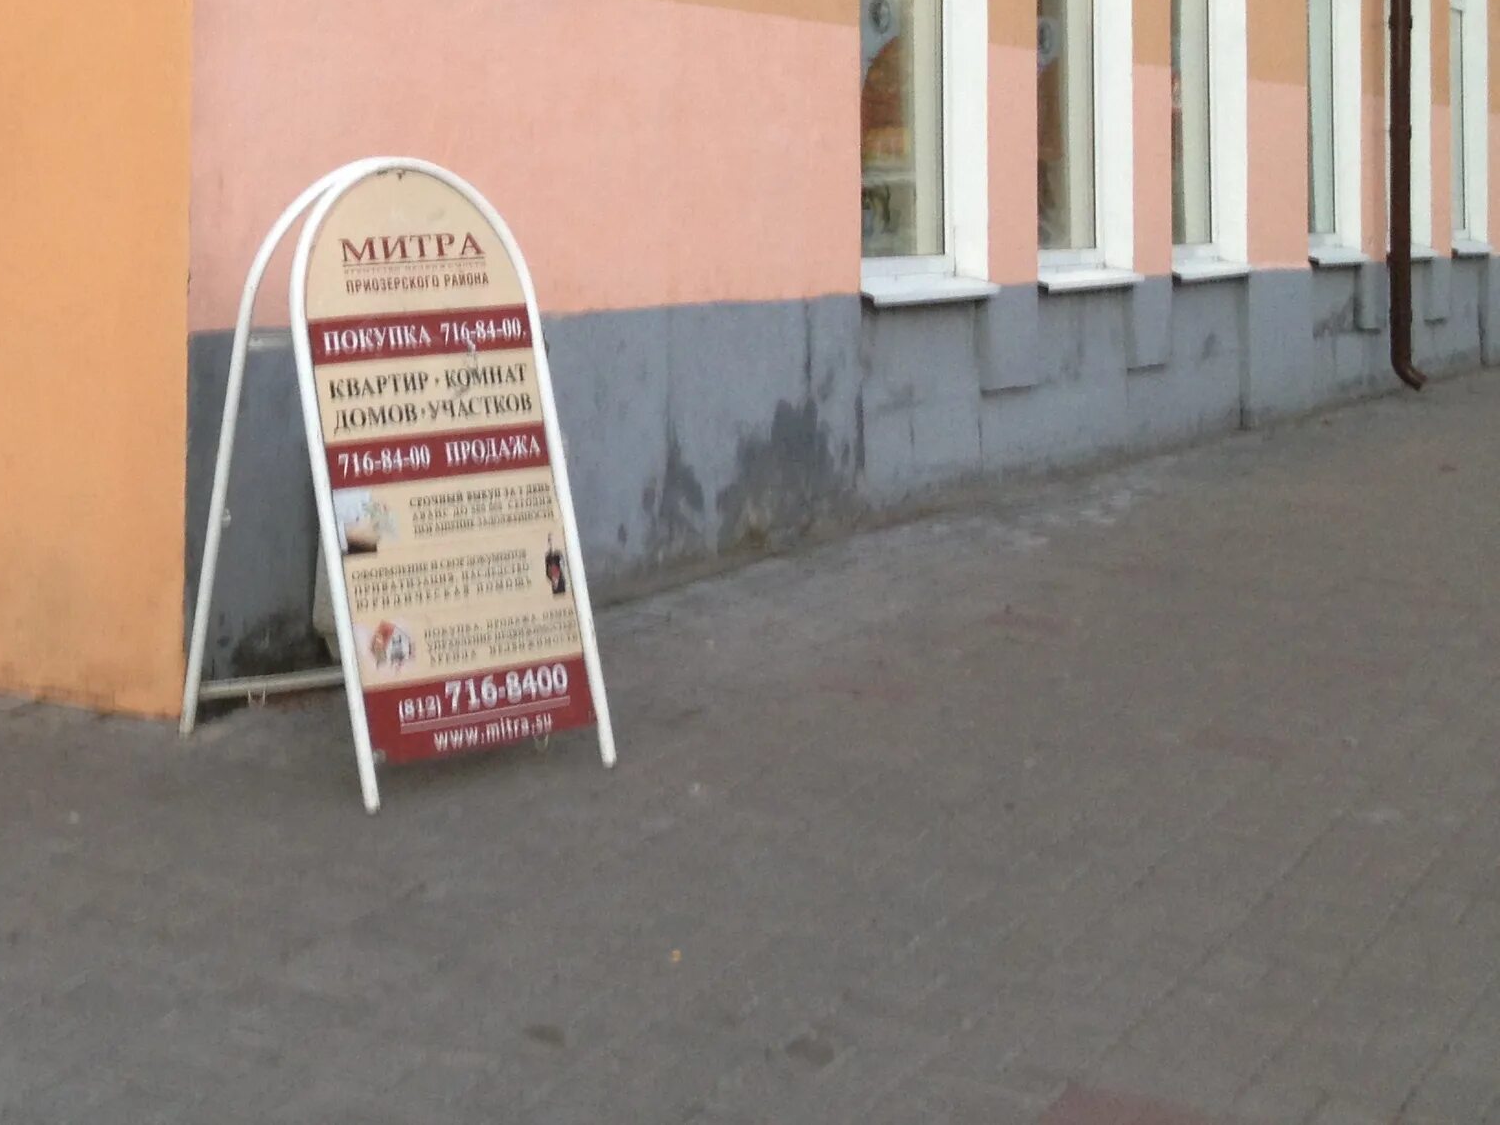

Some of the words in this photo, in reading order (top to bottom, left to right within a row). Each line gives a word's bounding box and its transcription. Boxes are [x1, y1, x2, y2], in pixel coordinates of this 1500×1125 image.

[339, 231, 485, 262] МИТРА
[346, 276, 440, 294] ПРИОЗЕРСКОГО
[323, 325, 431, 355] ПОКУПКА
[329, 371, 428, 399] КВАРТИР
[445, 363, 527, 388] КОМНАТ
[333, 402, 418, 435] ДОМОВ
[428, 393, 532, 420] УЧАСТКОВ
[338, 445, 431, 479] 716-84-00
[445, 435, 541, 466] ПРОДАЖА
[399, 695, 441, 722] (812)
[445, 663, 568, 714] 716-8400
[434, 713, 552, 751] www.mitra.su
